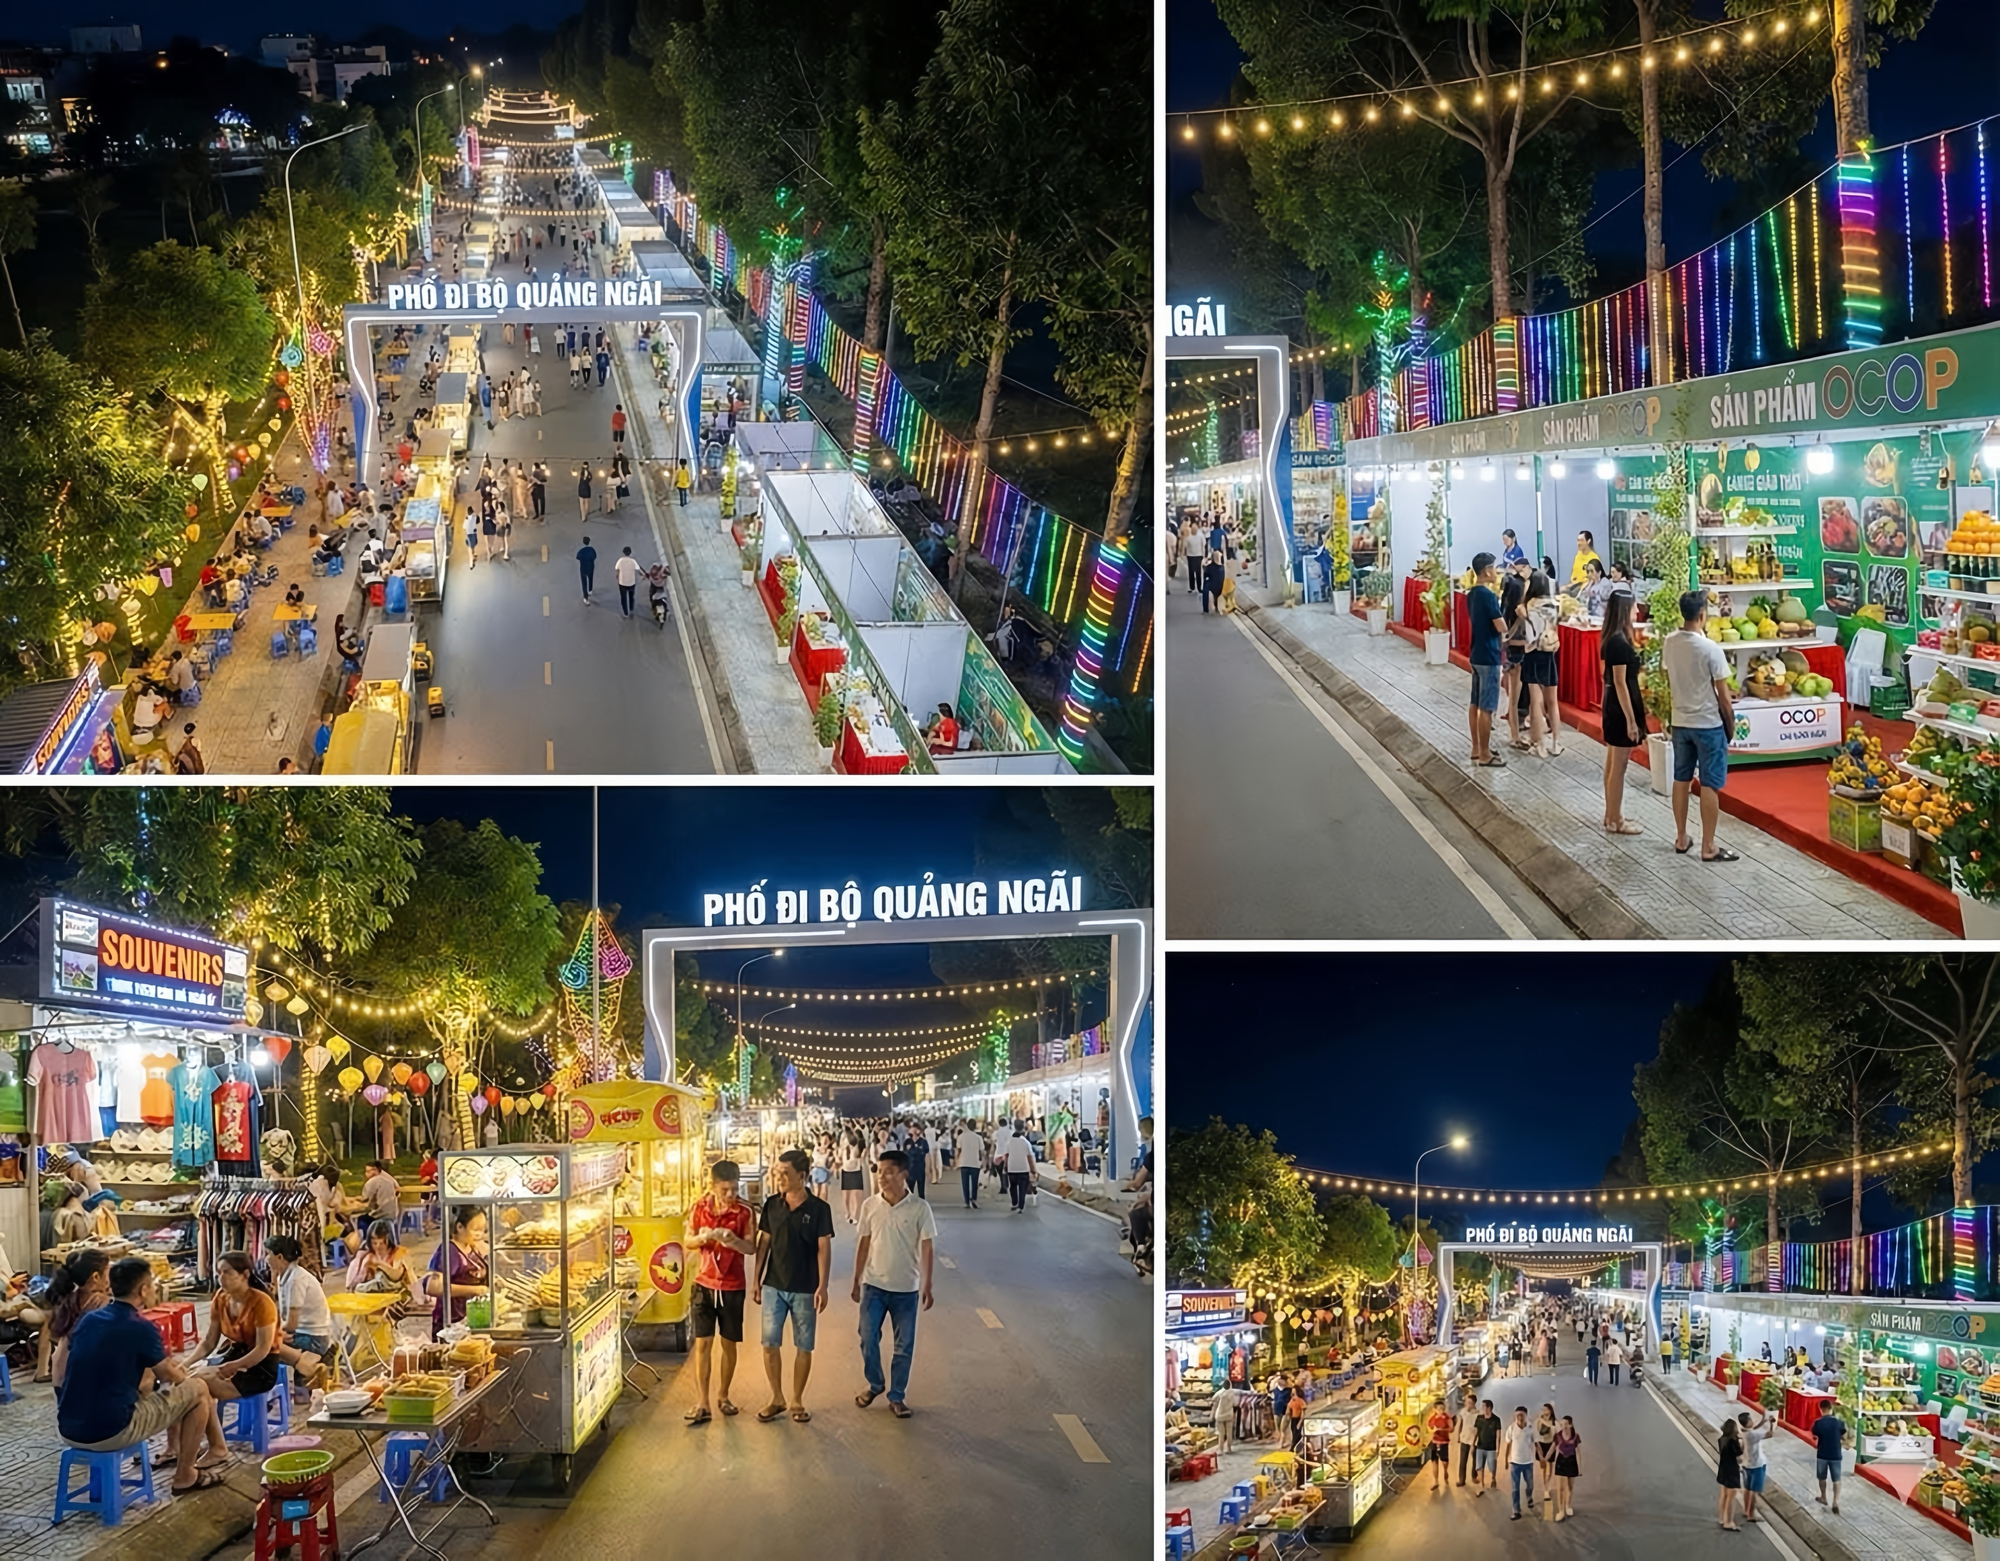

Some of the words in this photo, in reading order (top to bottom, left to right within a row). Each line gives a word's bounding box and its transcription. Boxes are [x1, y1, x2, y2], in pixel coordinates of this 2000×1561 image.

[388, 273, 438, 310] PHỐ
[444, 283, 469, 309] ĐI
[476, 276, 509, 314] BỘ
[516, 273, 598, 311] QUẢNG
[604, 272, 662, 307] NGÃI
[1709, 382, 1749, 429] SẢN
[1753, 368, 1817, 425] PHẨM
[1821, 347, 1959, 420] OCOP
[1780, 708, 1827, 725] OCOP
[703, 878, 768, 927] PHỐ
[775, 889, 808, 924] ĐI
[819, 880, 862, 929] BỘ
[873, 871, 988, 923] QUẢNG
[998, 869, 1082, 915] NGÃI
[101, 928, 224, 987] SOUVENIRS
[1465, 1222, 1496, 1243] PHỐ
